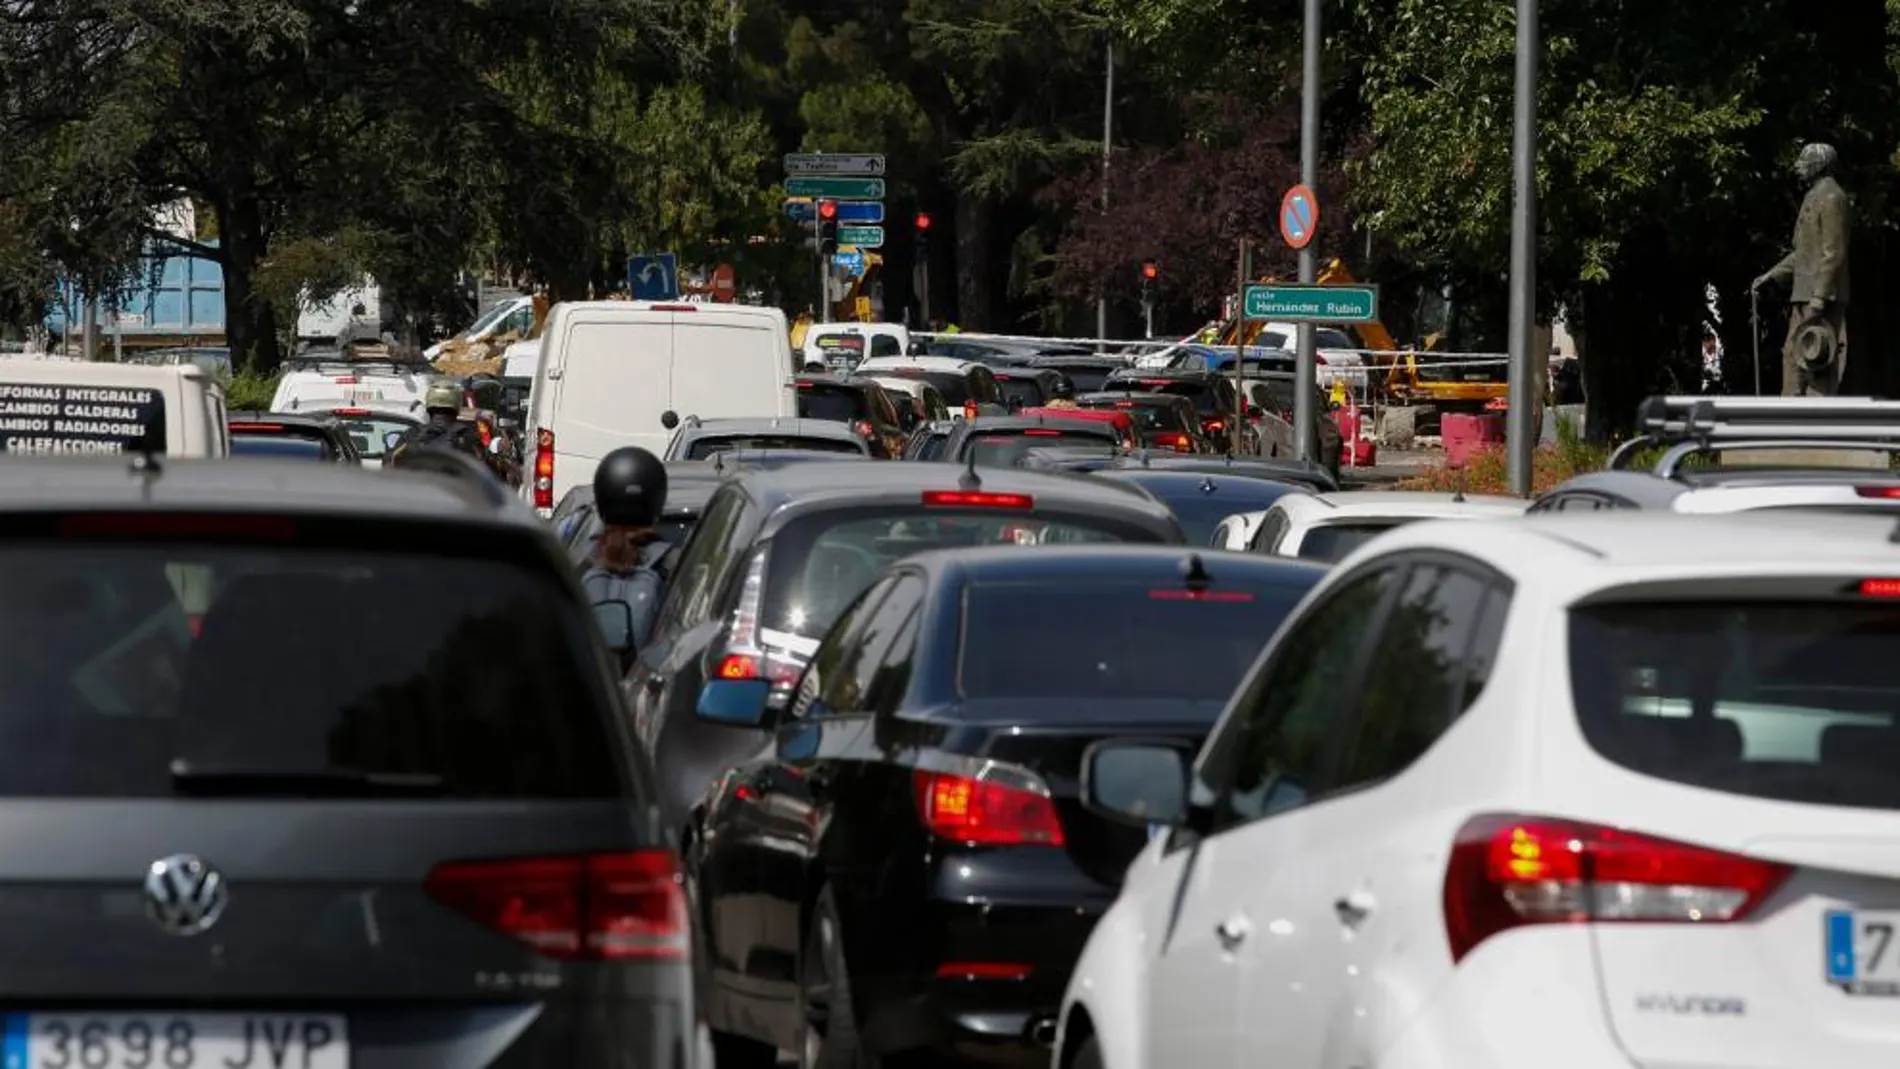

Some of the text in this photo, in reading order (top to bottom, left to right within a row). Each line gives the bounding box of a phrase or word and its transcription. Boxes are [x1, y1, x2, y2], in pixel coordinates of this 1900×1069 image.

[66, 391, 152, 403] INTEGRALES
[64, 404, 138, 420] CALDERAS
[54, 420, 146, 437] RADIADORES
[6, 436, 123, 454] CALEFACCIONES
[42, 1018, 334, 1069] 3698 JVP
